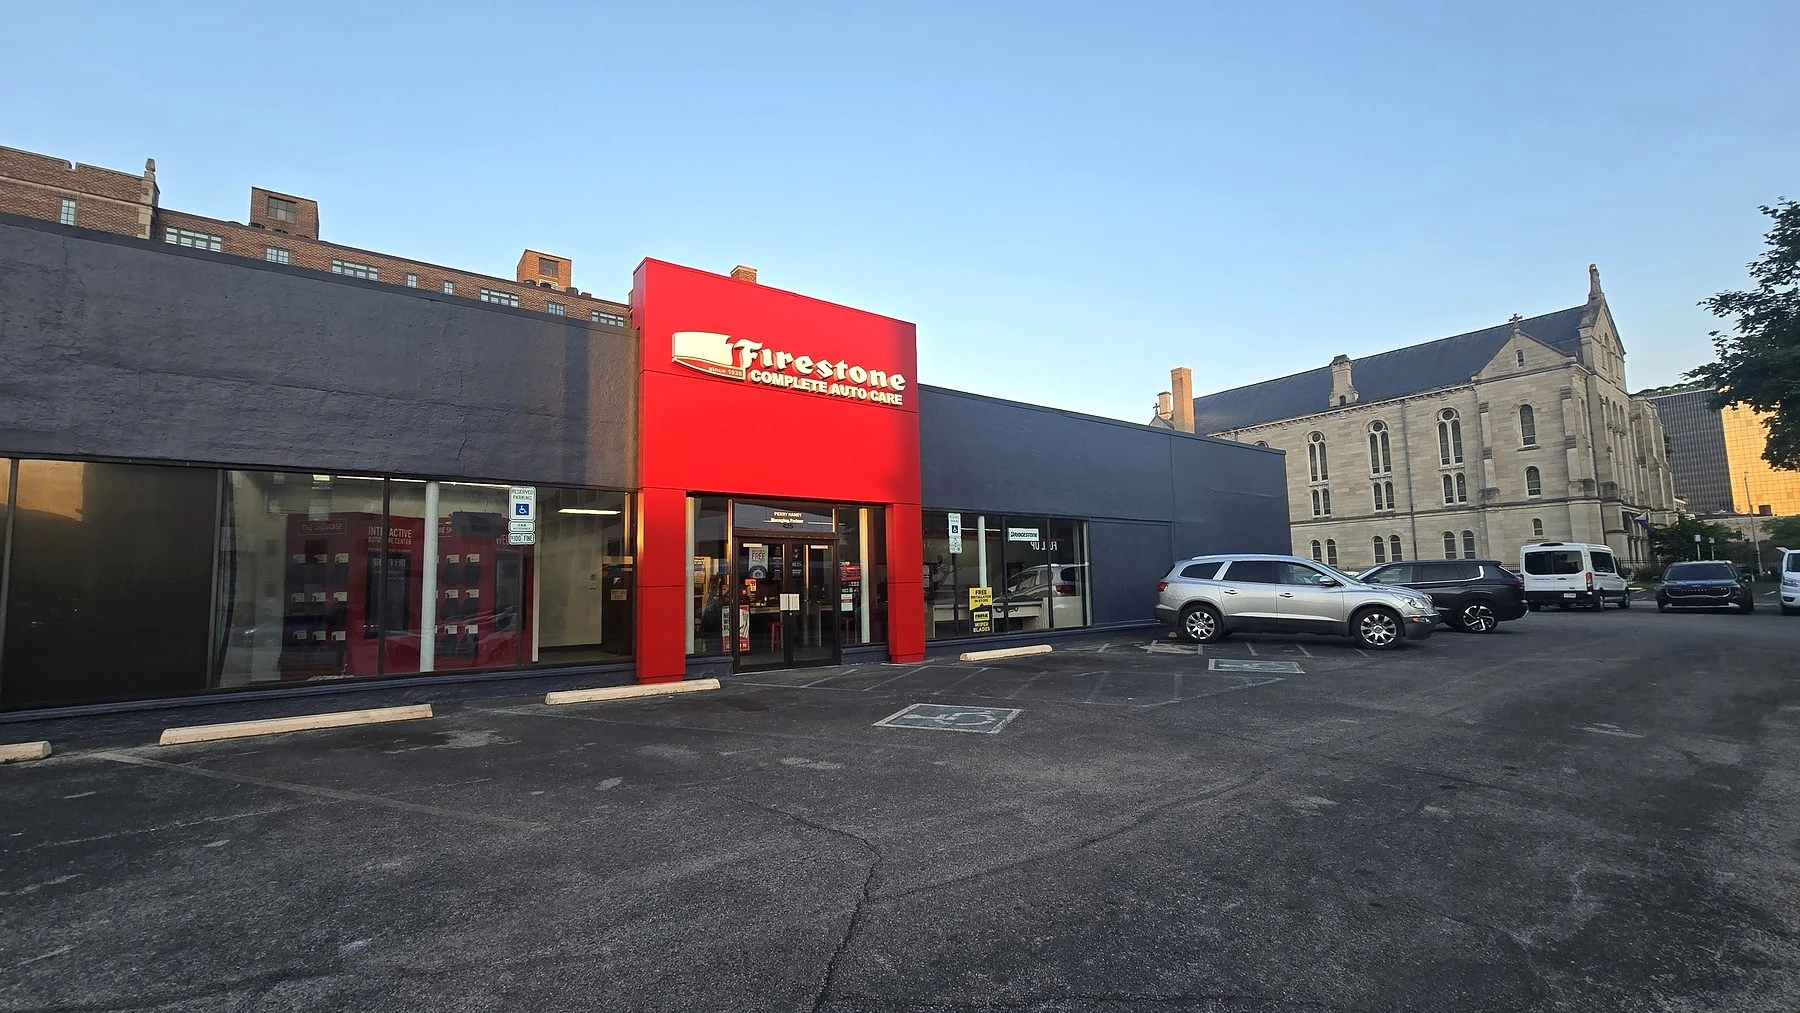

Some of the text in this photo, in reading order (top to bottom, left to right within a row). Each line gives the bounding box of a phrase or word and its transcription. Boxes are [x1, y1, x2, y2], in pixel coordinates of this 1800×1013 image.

[728, 368, 742, 376] 1926
[733, 338, 907, 392] Firestone
[749, 369, 903, 406] COMPLETE AUTO CARE
[368, 526, 412, 539] INTEACTIVE
